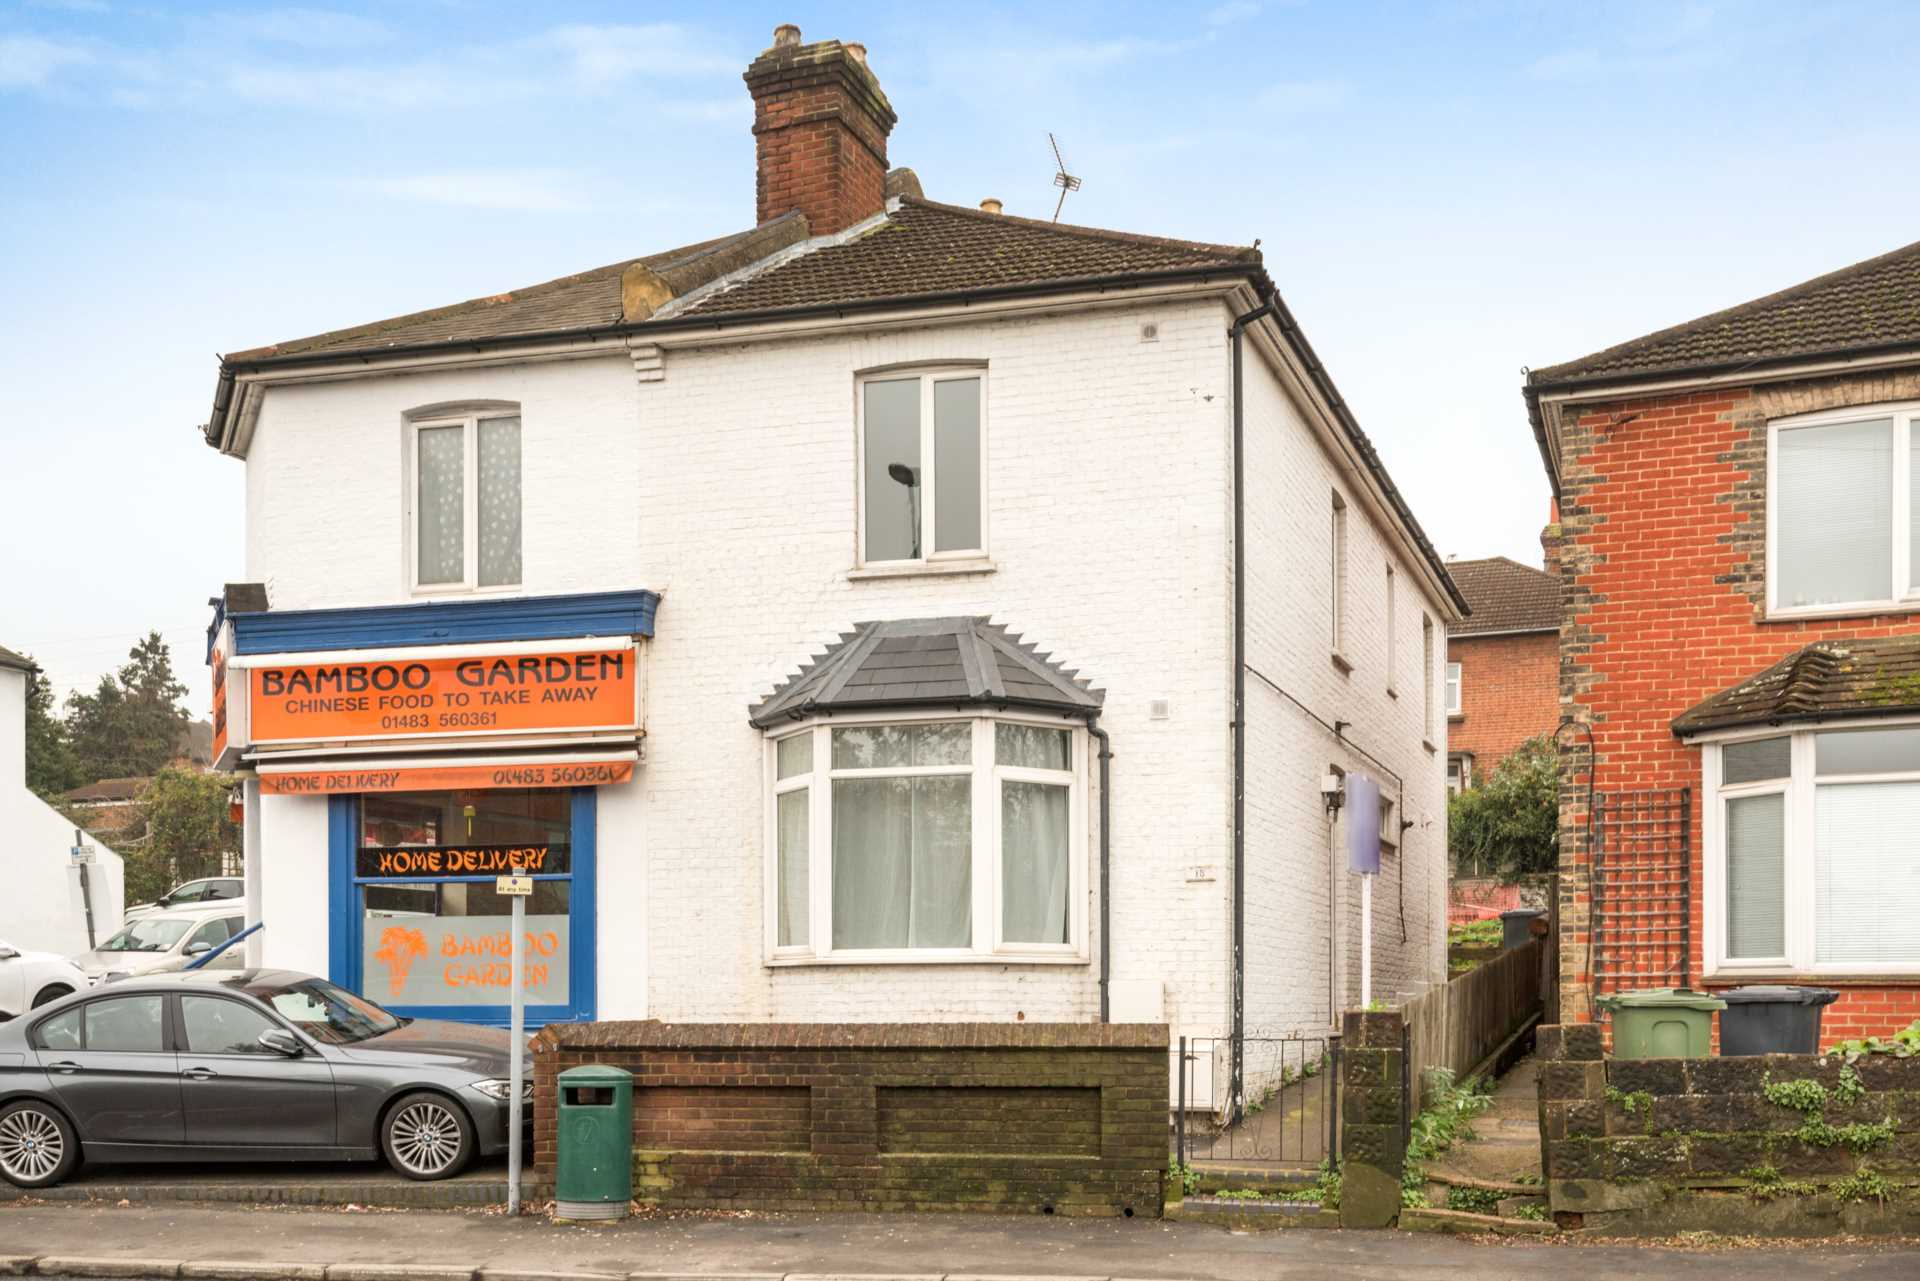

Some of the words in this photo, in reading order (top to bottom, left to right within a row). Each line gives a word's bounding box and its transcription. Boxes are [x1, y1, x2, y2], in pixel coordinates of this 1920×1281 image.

[262, 663, 431, 696] BAMBOO
[456, 653, 623, 687] GARDEN
[285, 697, 370, 714] CHINESE
[379, 694, 433, 710] FOOD
[444, 692, 470, 707] TO
[480, 689, 531, 705] TAKE
[541, 686, 598, 704] AWAY
[381, 714, 430, 729] 01483
[439, 711, 497, 727] 560361
[275, 776, 320, 791] HOME
[326, 772, 400, 789] DELIVERY
[493, 769, 545, 784] 01483
[551, 767, 614, 784] 560361
[379, 851, 441, 873] HOME
[446, 848, 548, 871] DELIVERY
